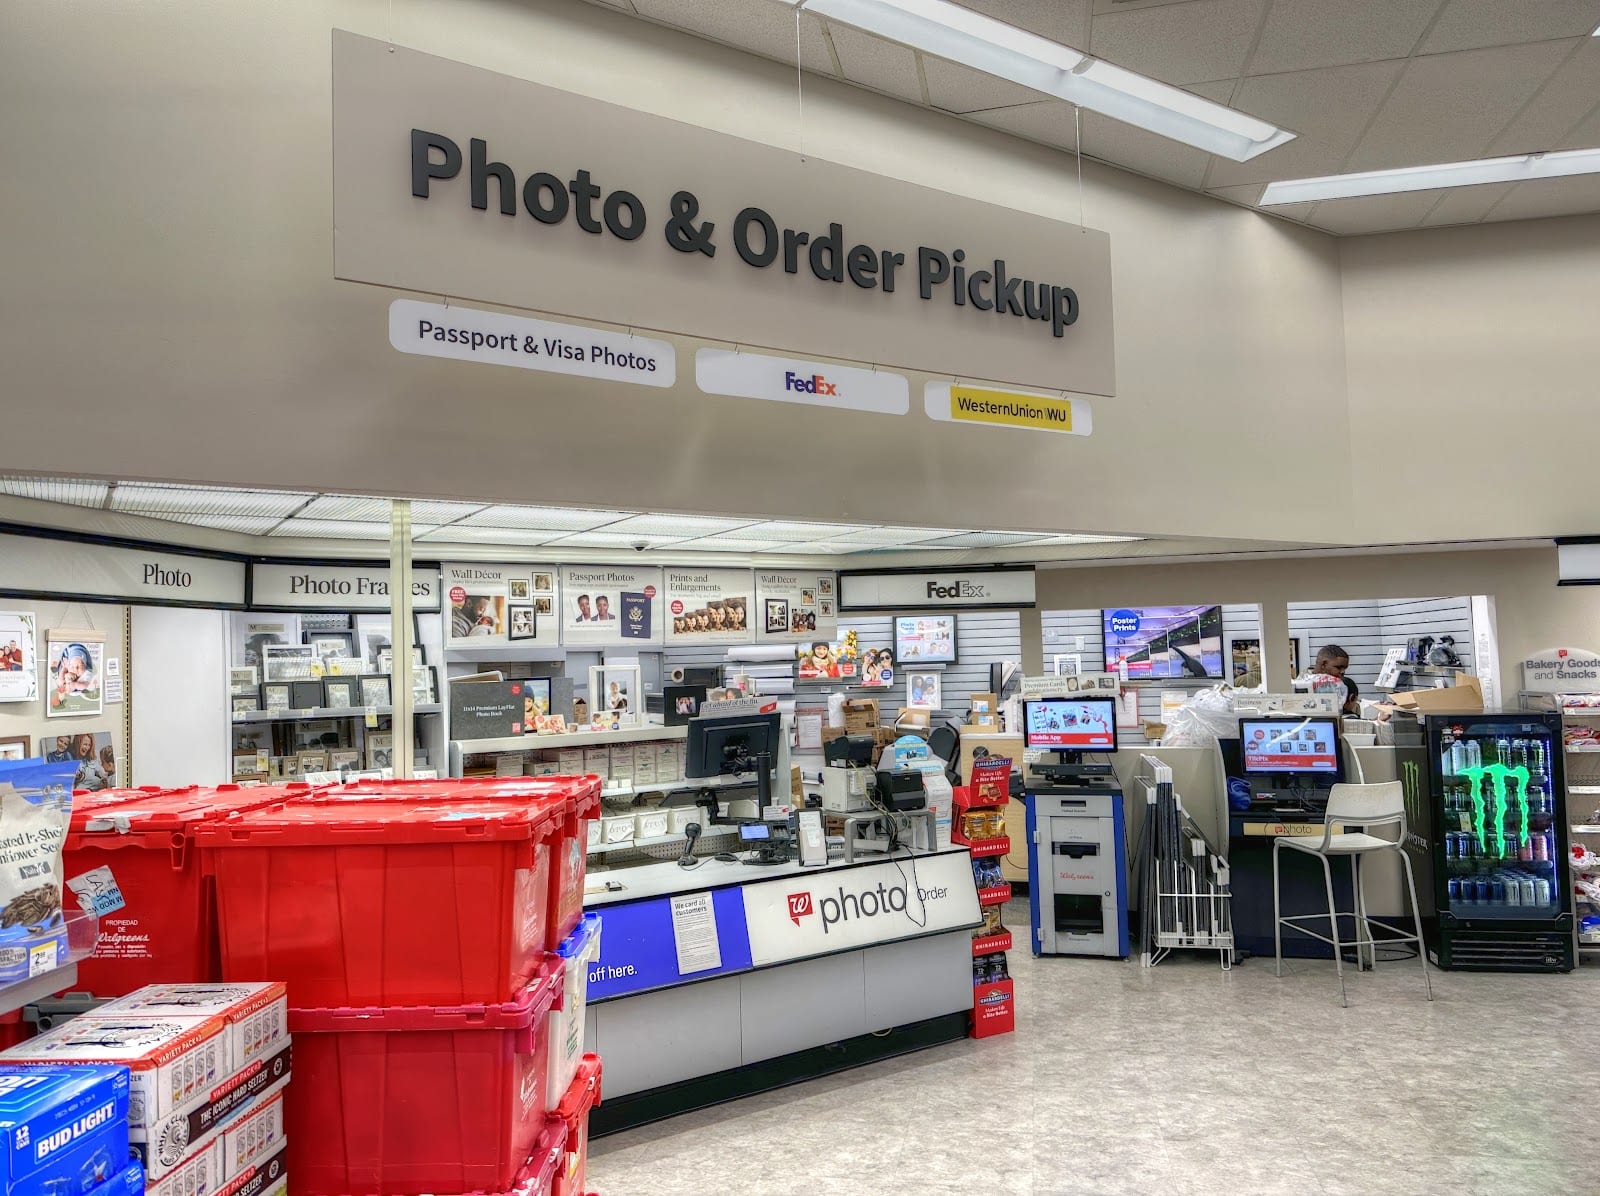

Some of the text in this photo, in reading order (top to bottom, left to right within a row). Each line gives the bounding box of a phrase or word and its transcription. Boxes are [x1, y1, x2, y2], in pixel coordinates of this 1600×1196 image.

[411, 128, 1079, 338] Photo & Order Pickup
[419, 320, 656, 372] Passport & Visa Photos
[785, 371, 837, 396] FedEx
[957, 397, 1043, 419] WesternUnion
[142, 563, 192, 588] Photo
[451, 569, 503, 580] Wall Décor
[569, 572, 635, 583] Passport Photos
[670, 574, 708, 583] Prints and
[761, 576, 797, 584] Wall Décor
[289, 575, 431, 596] Photo Fraes
[670, 583, 721, 593] Enlargements
[927, 580, 985, 598] FedEx
[1113, 624, 1137, 632] Prints
[1526, 660, 1564, 670] Bakery
[1534, 670, 1597, 680] and Snacks
[674, 903, 685, 911] We
[684, 900, 698, 908] card
[675, 906, 708, 917] customers
[819, 882, 907, 934] photo
[917, 887, 948, 902] Order
[97, 932, 150, 946] Walgreens
[589, 964, 638, 983] off here.
[233, 1008, 253, 1020] VARIETY
[158, 1045, 182, 1064] VARIETY
[200, 1071, 269, 1124] THE ICONIC HARD SELTZER
[212, 1078, 238, 1099] VARIETY
[16, 1125, 30, 1140] 12
[38, 1127, 72, 1160] BUD
[73, 1102, 114, 1139] LIGHT
[158, 1123, 171, 1157] WHITE
